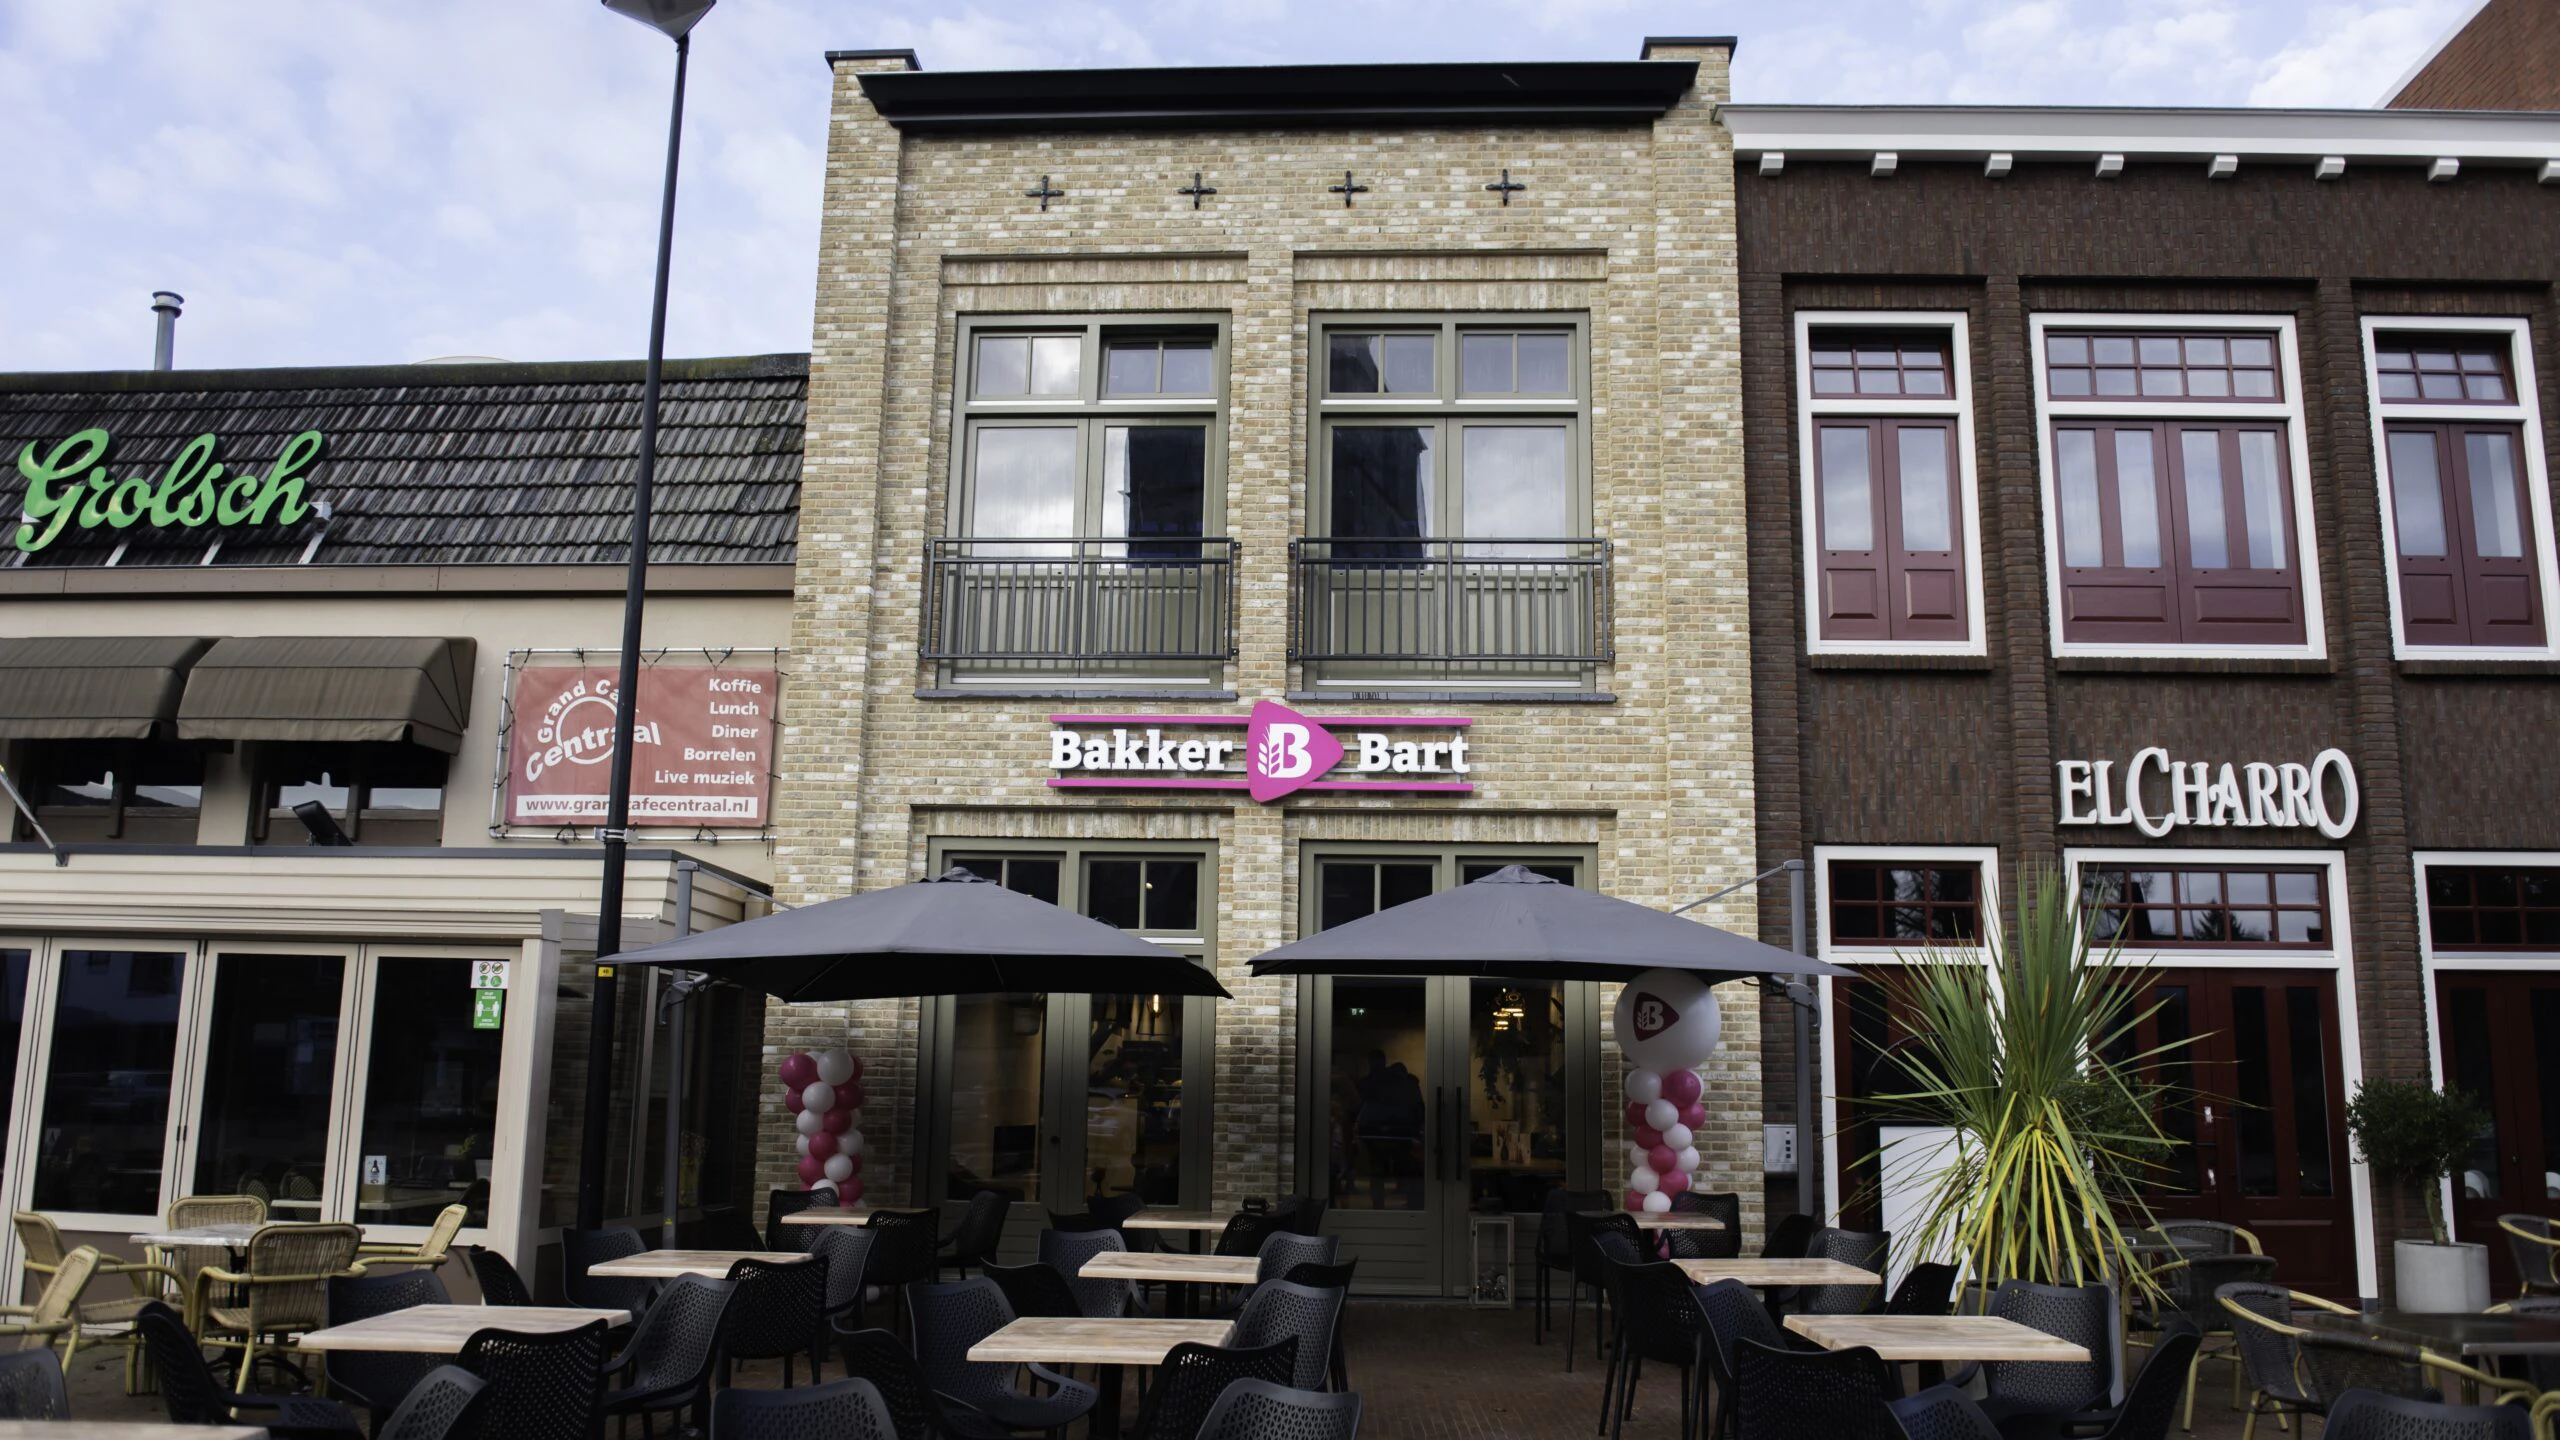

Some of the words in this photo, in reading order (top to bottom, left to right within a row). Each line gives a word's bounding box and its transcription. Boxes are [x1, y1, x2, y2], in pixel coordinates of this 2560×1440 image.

[15, 428, 322, 552] Grolsch
[709, 678, 762, 694] Koffie
[537, 680, 586, 744] Grand
[709, 701, 759, 715] Lunch
[711, 724, 759, 738] Diner
[526, 721, 662, 782] Central
[683, 747, 756, 762] Borrelen
[1049, 728, 1233, 771] Bakker
[1268, 723, 1313, 779] B
[1357, 732, 1471, 775] Bart
[654, 770, 689, 784] Live
[694, 771, 755, 785] muziek
